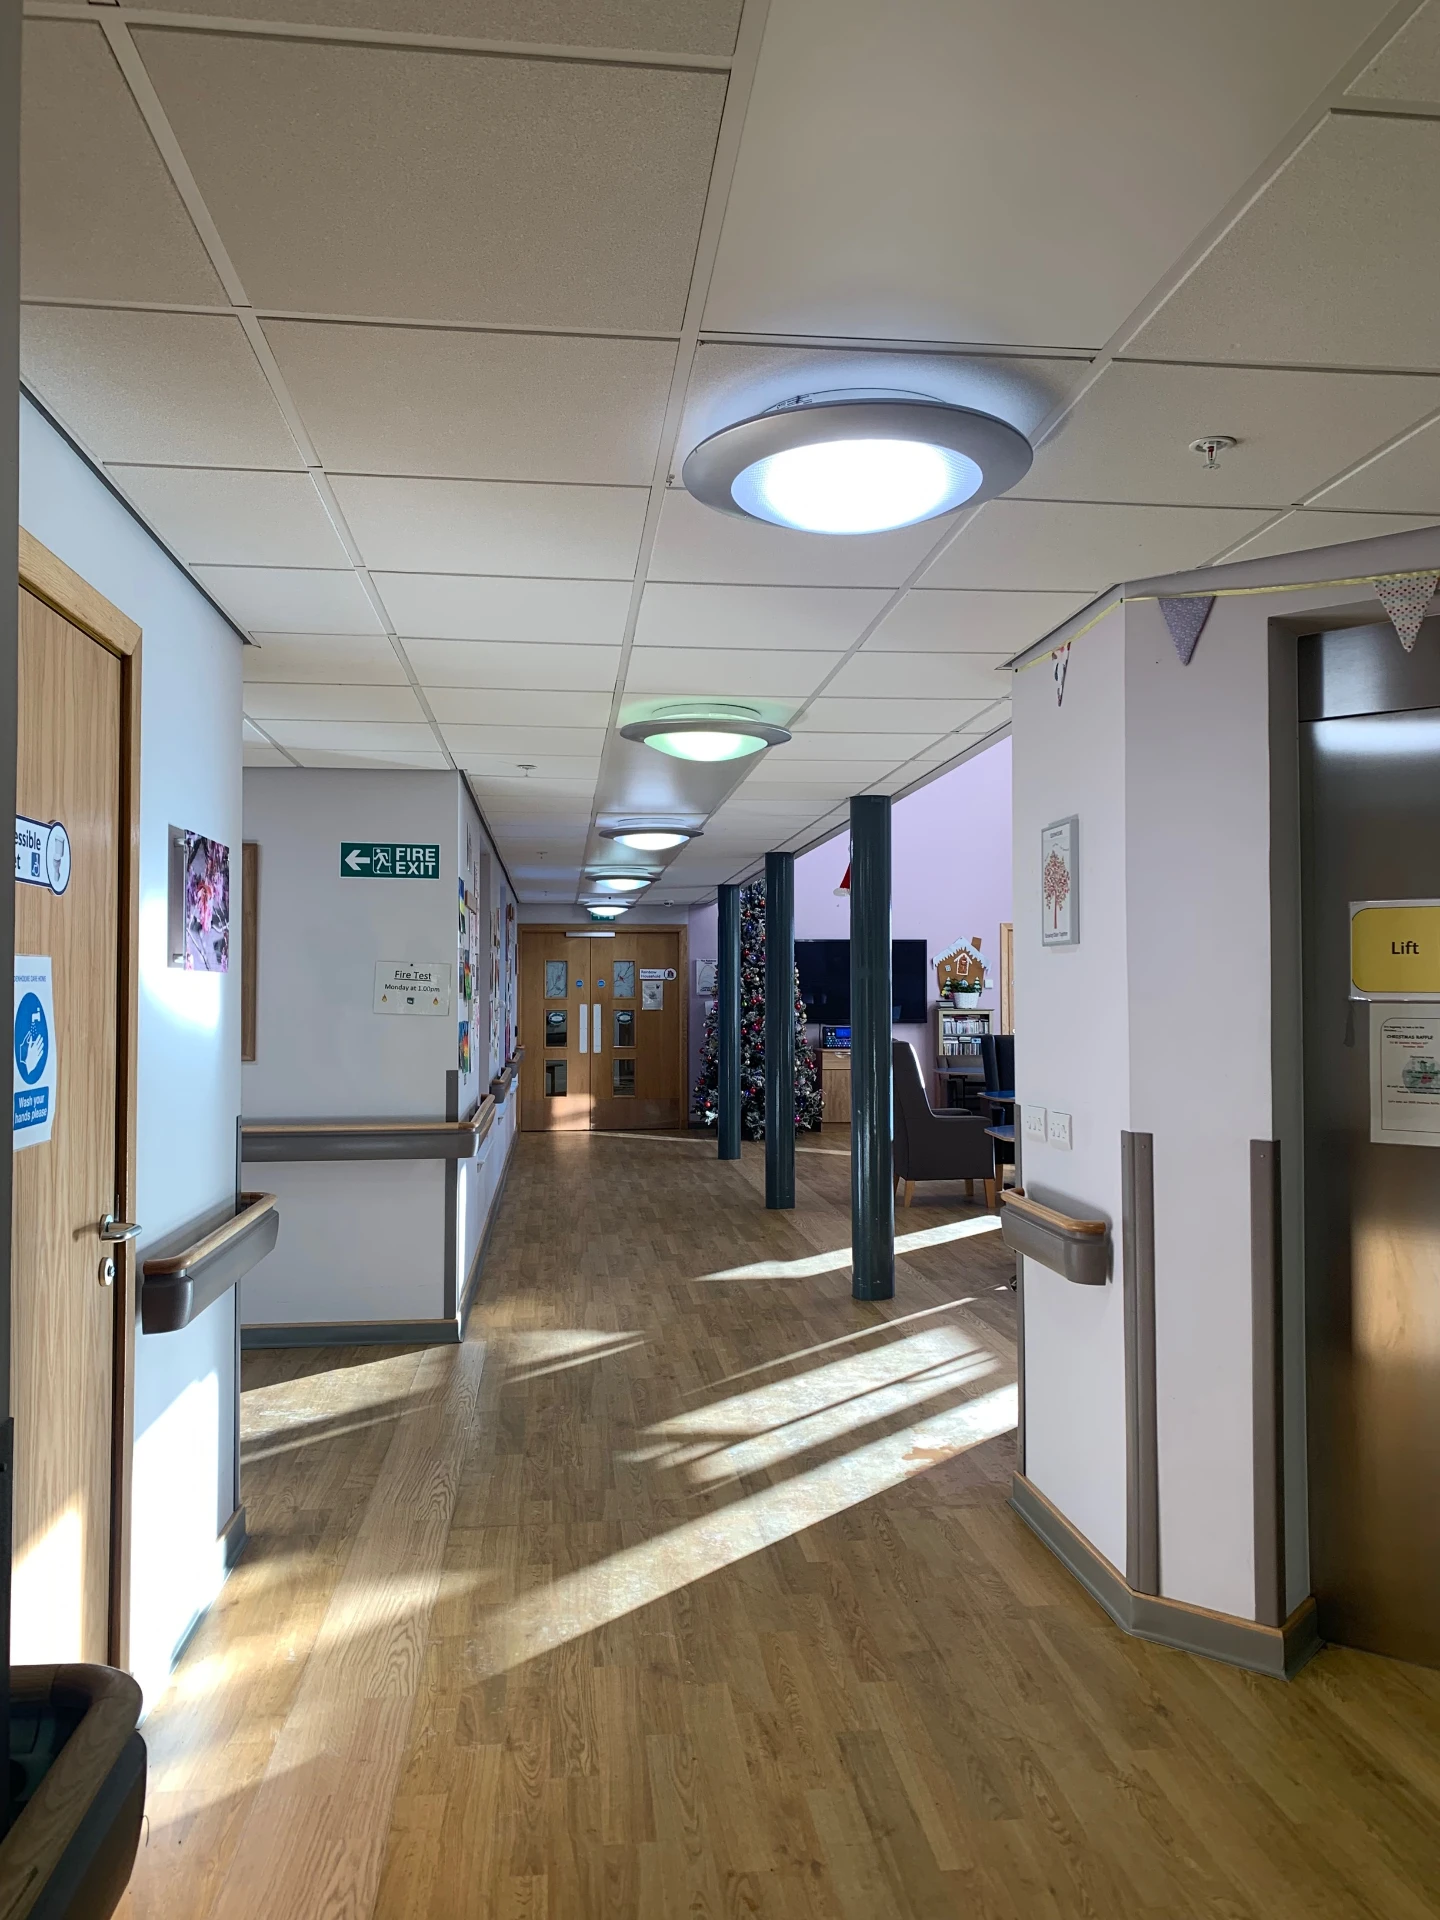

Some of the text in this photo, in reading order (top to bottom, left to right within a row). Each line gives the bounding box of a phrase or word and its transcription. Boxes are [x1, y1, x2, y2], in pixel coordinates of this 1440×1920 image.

[395, 847, 436, 862] FIRE
[395, 861, 436, 876] EXIT
[1391, 940, 1420, 955] Lift
[394, 970, 432, 980] Fire Test
[384, 983, 410, 992] Monday
[418, 985, 441, 994] 1.00pm
[18, 1094, 45, 1109] Wash your
[14, 1107, 48, 1124] hands please
